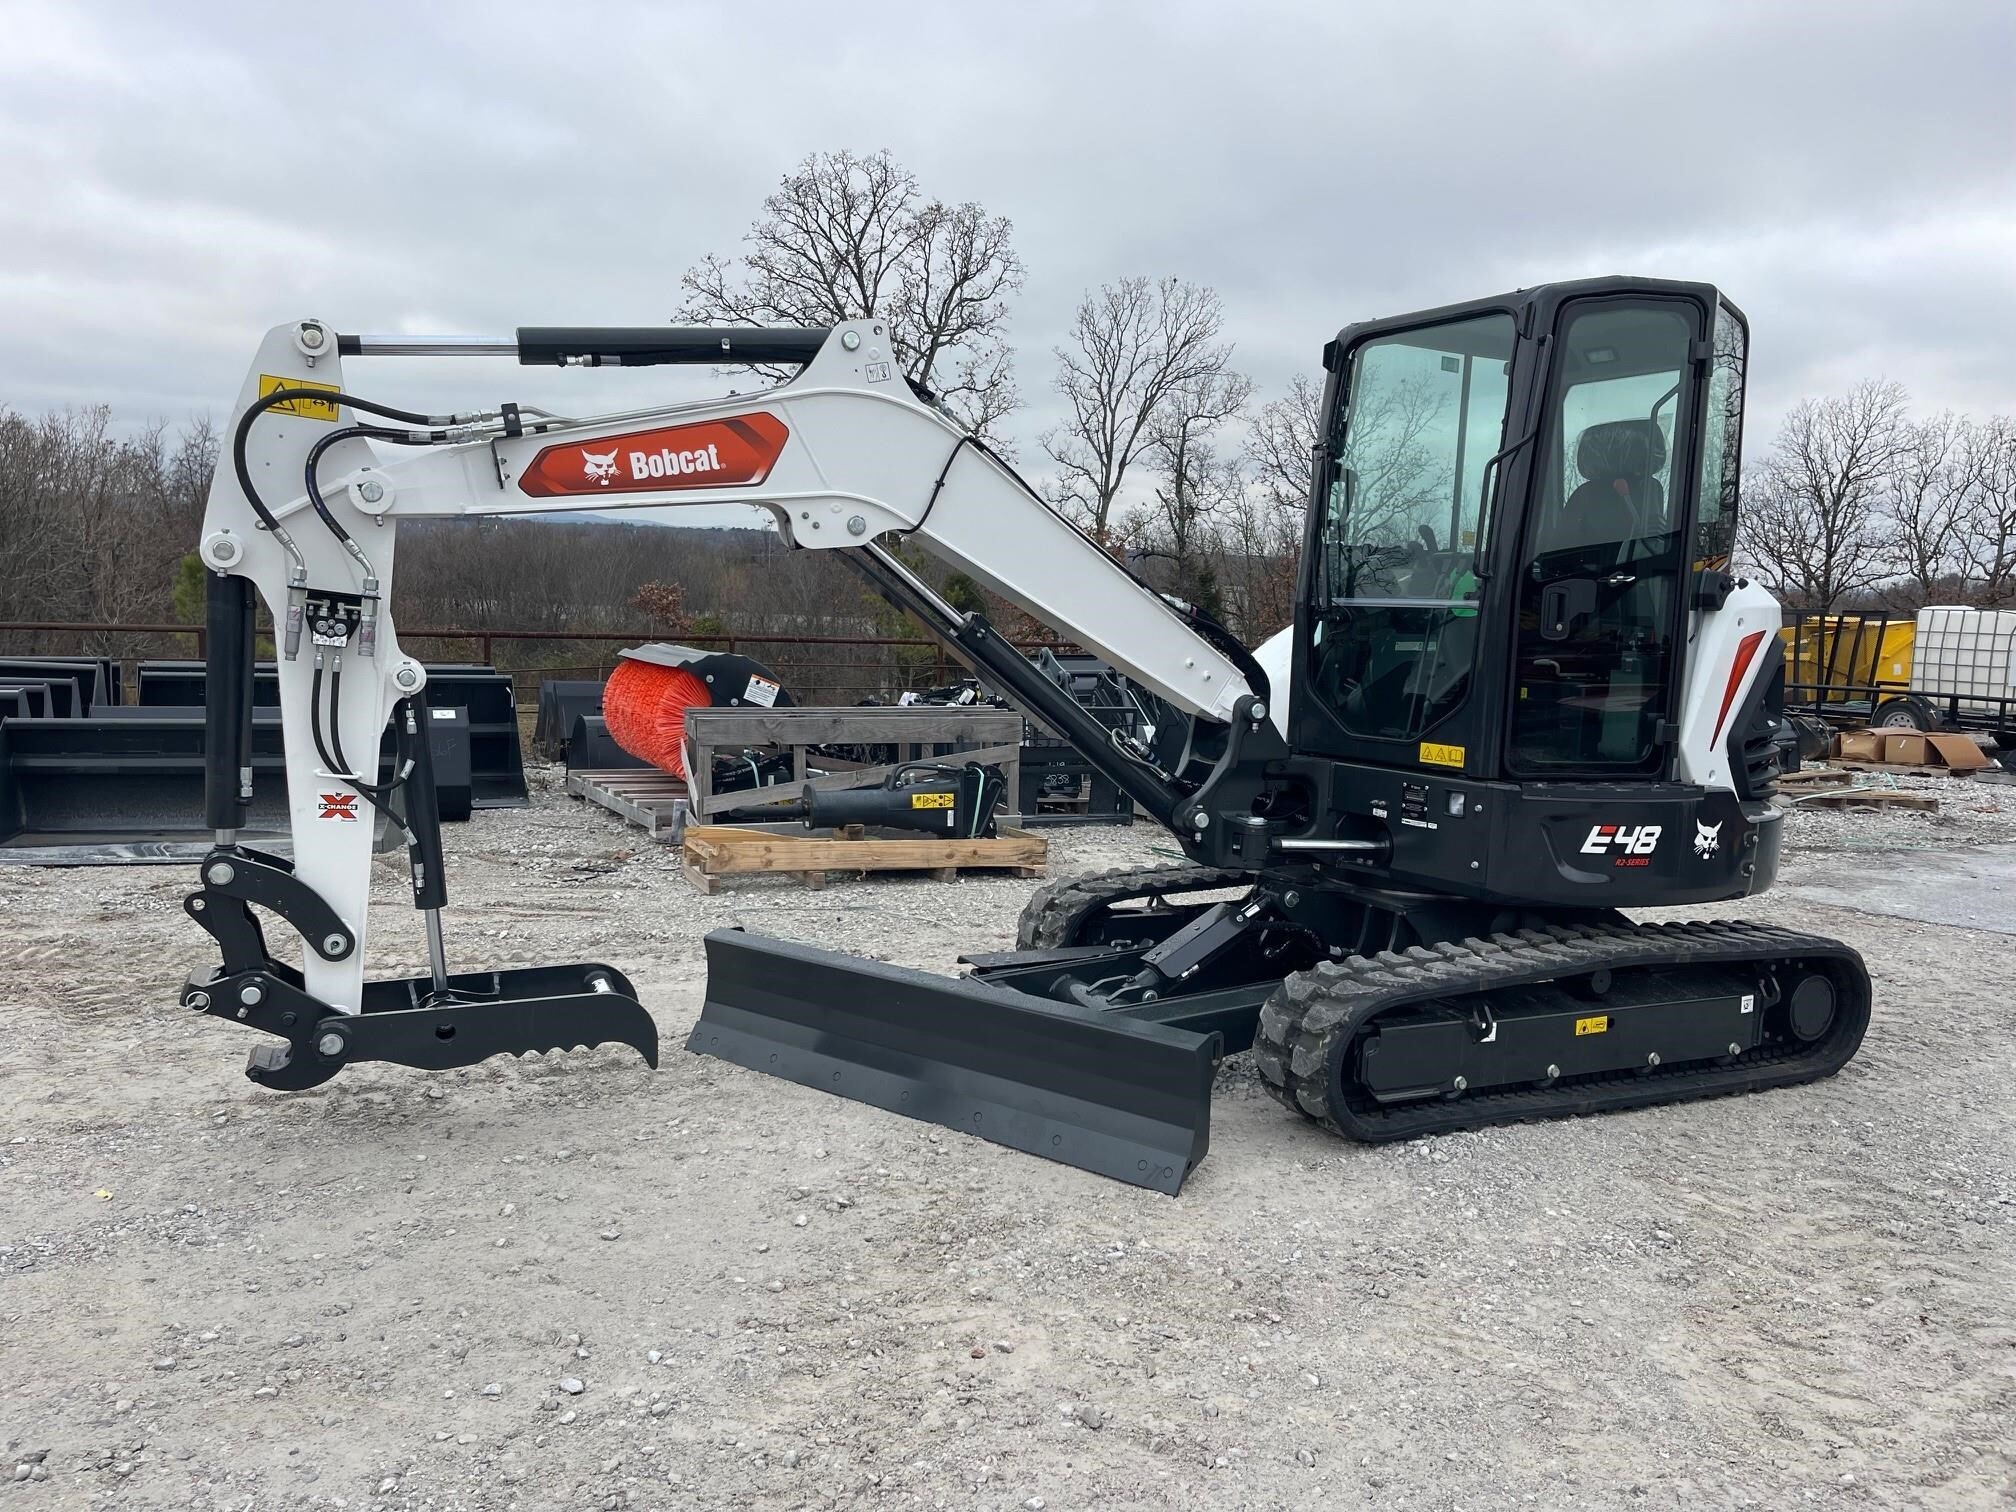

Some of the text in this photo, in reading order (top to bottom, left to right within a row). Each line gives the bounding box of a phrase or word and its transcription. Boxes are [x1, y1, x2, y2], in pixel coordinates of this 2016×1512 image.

[629, 444, 721, 480] Bobcat
[1580, 825, 1662, 854] E48
[1615, 858, 1650, 866] R2-SERIES
